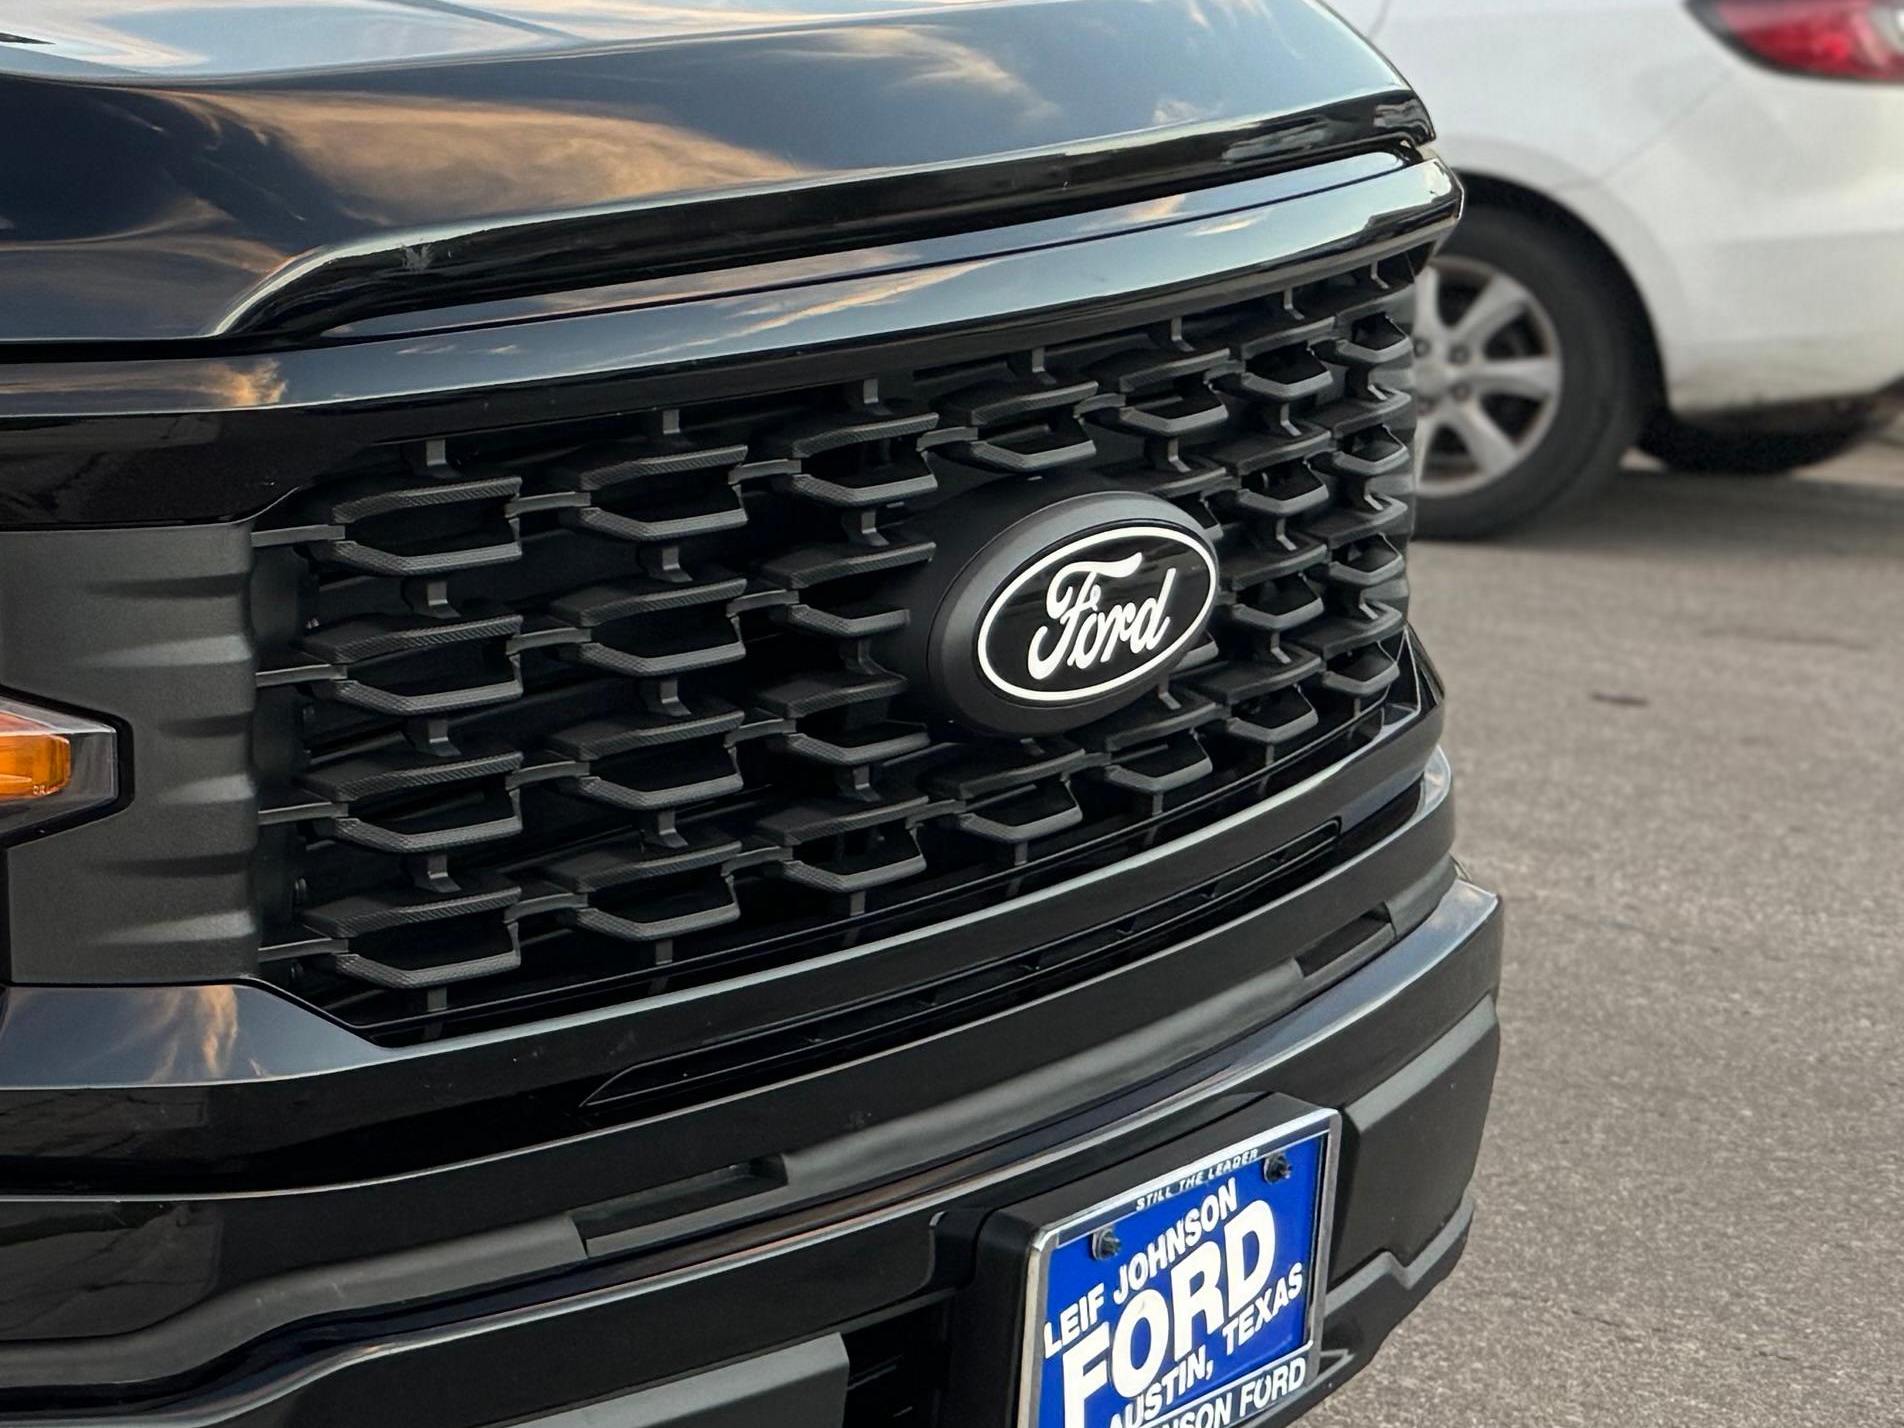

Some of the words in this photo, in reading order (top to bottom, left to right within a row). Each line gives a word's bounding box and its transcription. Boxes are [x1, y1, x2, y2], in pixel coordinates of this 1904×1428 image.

[1028, 552, 1176, 680] Ford
[1135, 1189, 1173, 1212] STILL
[1179, 1174, 1204, 1194] THE
[1208, 1148, 1259, 1180] LEADER
[1043, 1282, 1104, 1359] LEIF
[1113, 1177, 1238, 1304] JOHNSON
[1222, 1262, 1303, 1356] TEXAS
[1239, 1357, 1307, 1418] FORD
